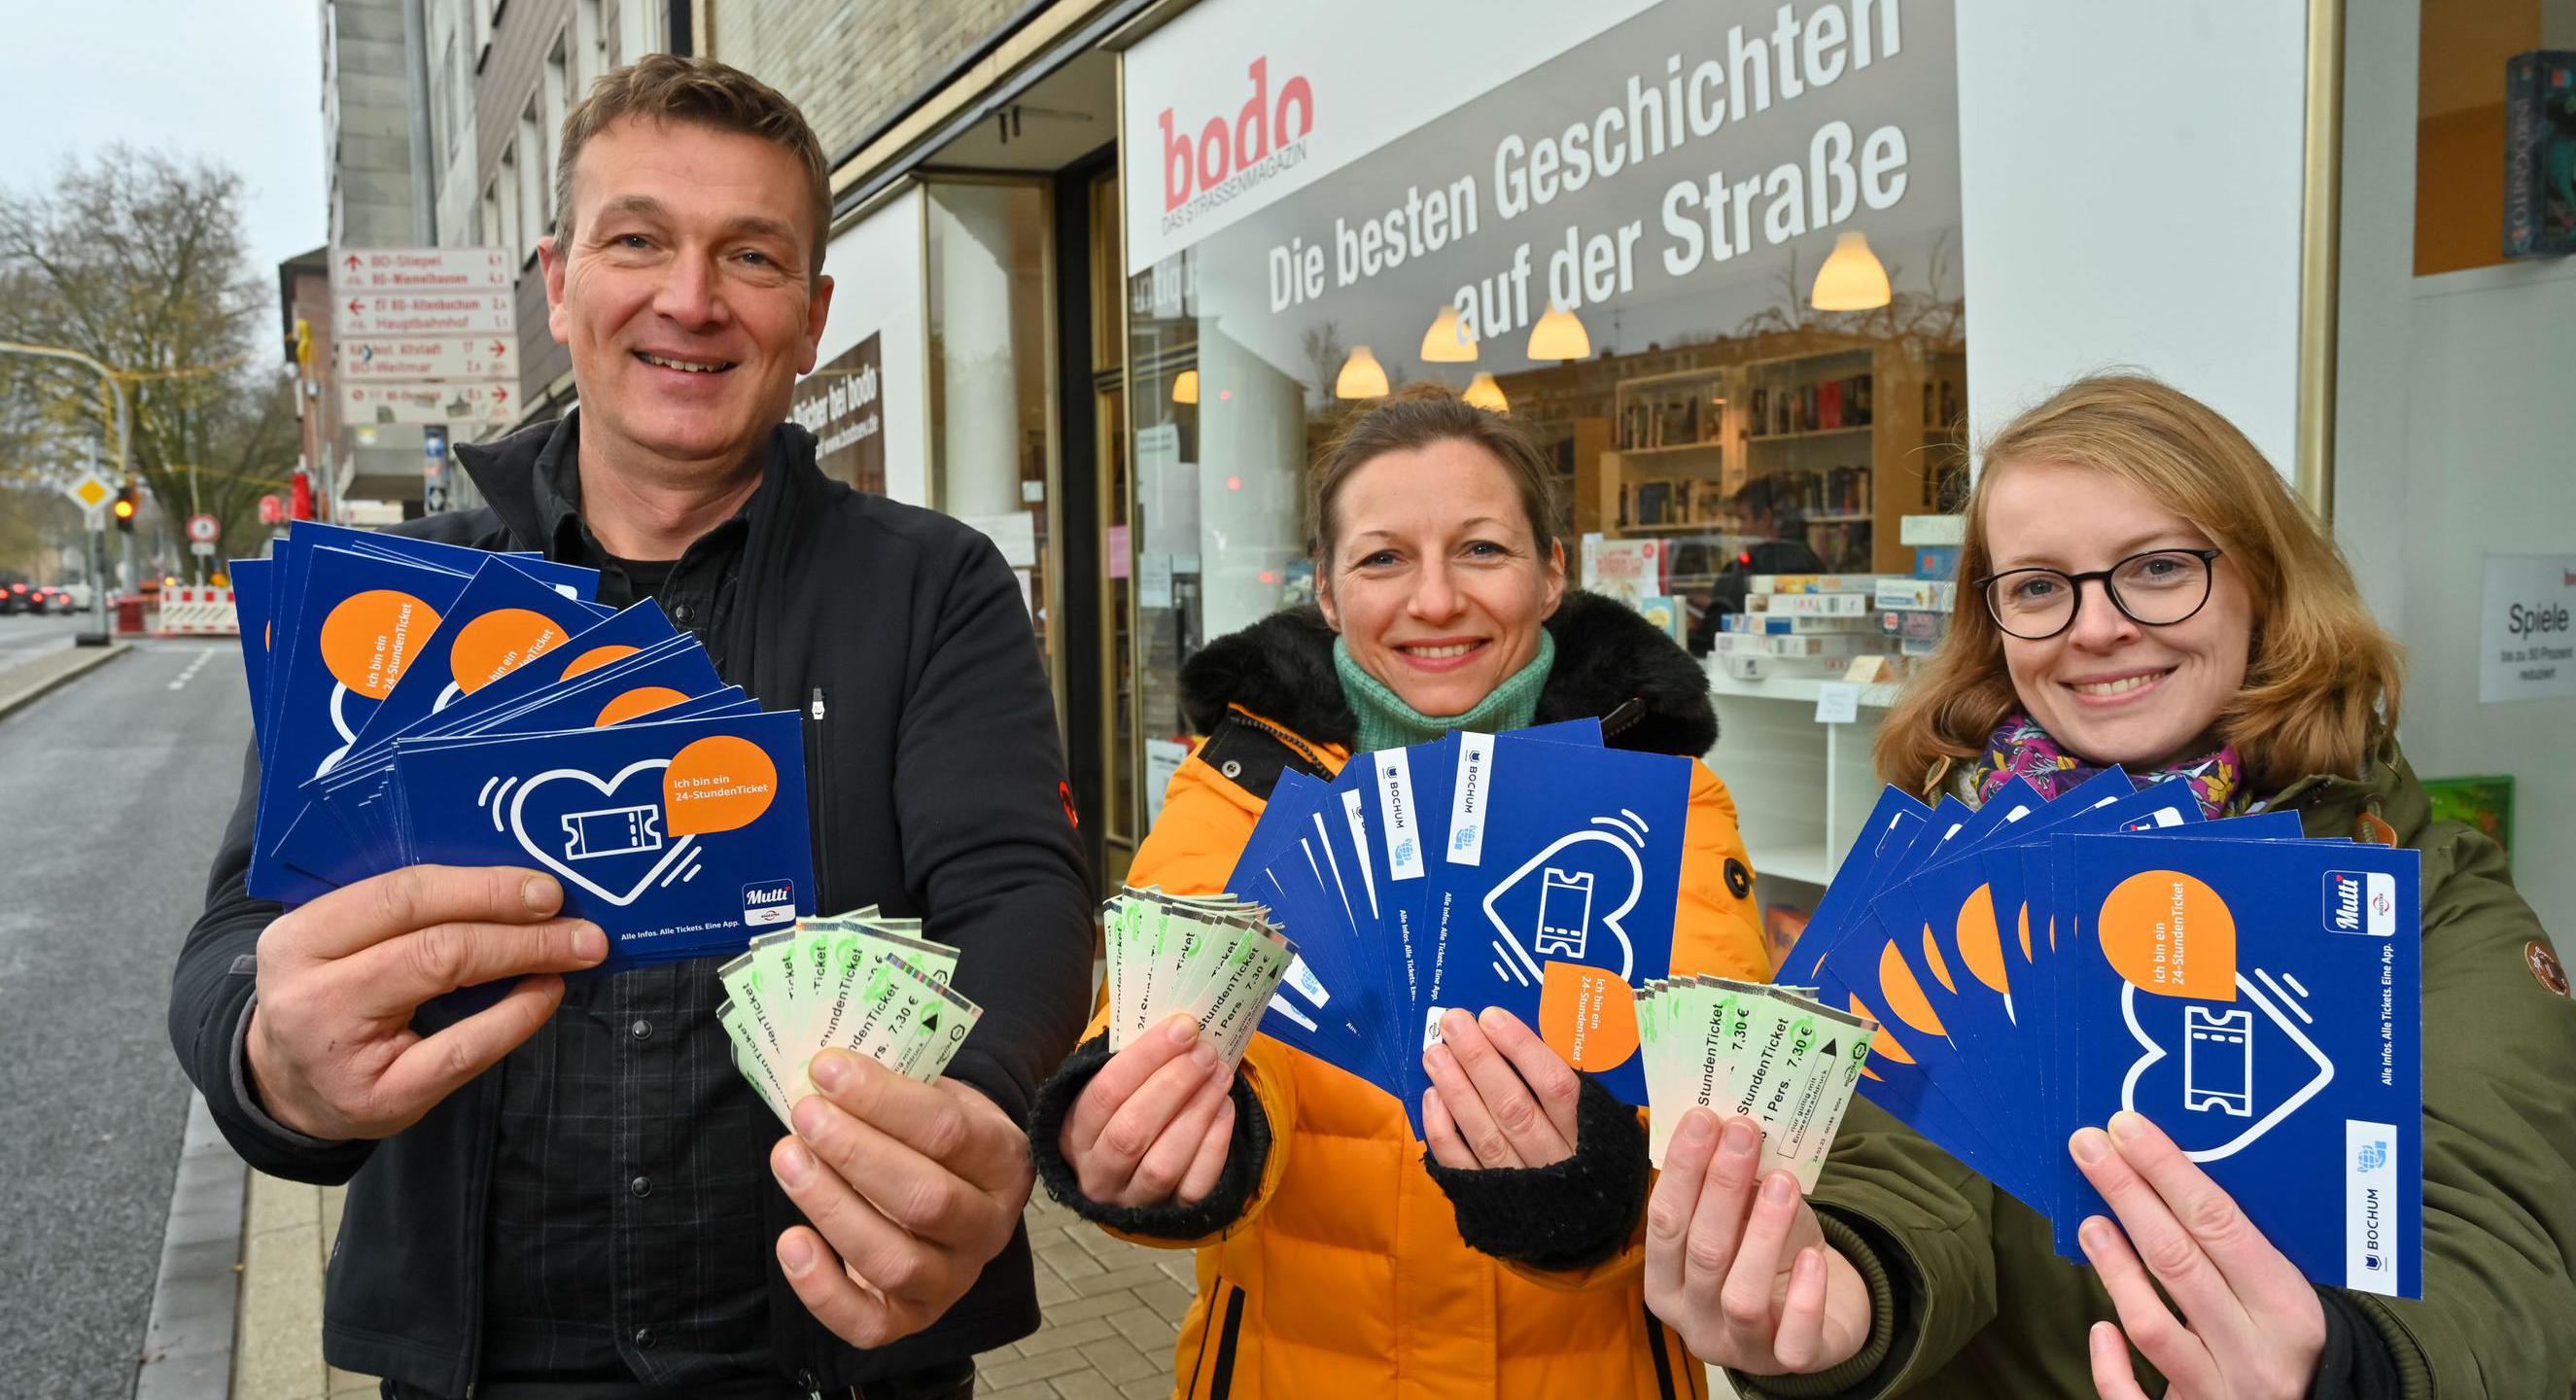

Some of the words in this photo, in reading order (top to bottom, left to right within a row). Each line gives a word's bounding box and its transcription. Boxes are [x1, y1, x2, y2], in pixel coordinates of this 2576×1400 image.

[1158, 55, 1313, 213] bodo
[1270, 236, 1325, 314] Die
[1336, 174, 1478, 288] besten
[1495, 0, 1900, 220] Geschichten
[1162, 207, 1184, 236] DAS
[1186, 139, 1306, 224] STRASSENMAGAZIN
[1453, 242, 1531, 347] auf
[1549, 219, 1642, 314] der
[1661, 121, 1907, 277] Straße
[2509, 602, 2569, 641] Spiele
[376, 635, 387, 652] ein
[371, 652, 383, 670] bin
[502, 649, 518, 666] ein
[367, 671, 378, 688] Ich
[674, 779, 690, 788] Ich
[693, 777, 711, 787] bin
[714, 775, 730, 784] ein
[676, 784, 768, 801] 24-StundenTicket
[1465, 766, 1479, 814] BOCHUM
[1390, 782, 1405, 829] BOCHUM
[747, 886, 791, 905] Mutti
[2335, 874, 2359, 929] Mutti
[1442, 906, 1450, 926] Infos.
[638, 930, 659, 939] Infos.
[676, 925, 704, 933] Tickets.
[722, 920, 740, 928] App.
[1440, 927, 1448, 941] Alle
[2153, 923, 2165, 940] ein
[2171, 882, 2184, 985] 24-StundenTicket
[1436, 942, 1446, 967] Tickets.
[2153, 944, 2165, 962] bin
[2382, 943, 2394, 963] App.
[1407, 959, 1416, 986] Tickets.
[1434, 968, 1443, 985] Eine
[2153, 966, 2166, 983] Ich
[2382, 963, 2392, 985] Eine
[1198, 947, 1259, 1032] StundenTicket
[1220, 999, 1244, 1029] Pers.
[1263, 955, 1271, 964] €
[1431, 985, 1441, 1000] App.
[1595, 978, 1606, 993] Ich
[1593, 995, 1604, 1011] bin
[1737, 1008, 1750, 1018] €
[2382, 987, 2392, 1021] Tickets.
[888, 1007, 911, 1035] 7,30
[908, 996, 920, 1006] €
[1573, 976, 1592, 1062] 24-StundenTicket
[1591, 1014, 1600, 1030] ein
[1732, 1022, 1748, 1050] 7,30
[2382, 1022, 2392, 1039] Alle
[1698, 1003, 1723, 1106] StundenTicket
[2382, 1042, 2392, 1068] Infos.
[1737, 1018, 1789, 1115] StundenTicket
[1767, 1078, 1792, 1112] Pers.
[1787, 1039, 1807, 1068] 7,30
[1801, 1027, 1812, 1036] €
[2382, 1068, 2392, 1086] Alle
[2367, 1189, 2379, 1250] BOCHUM
